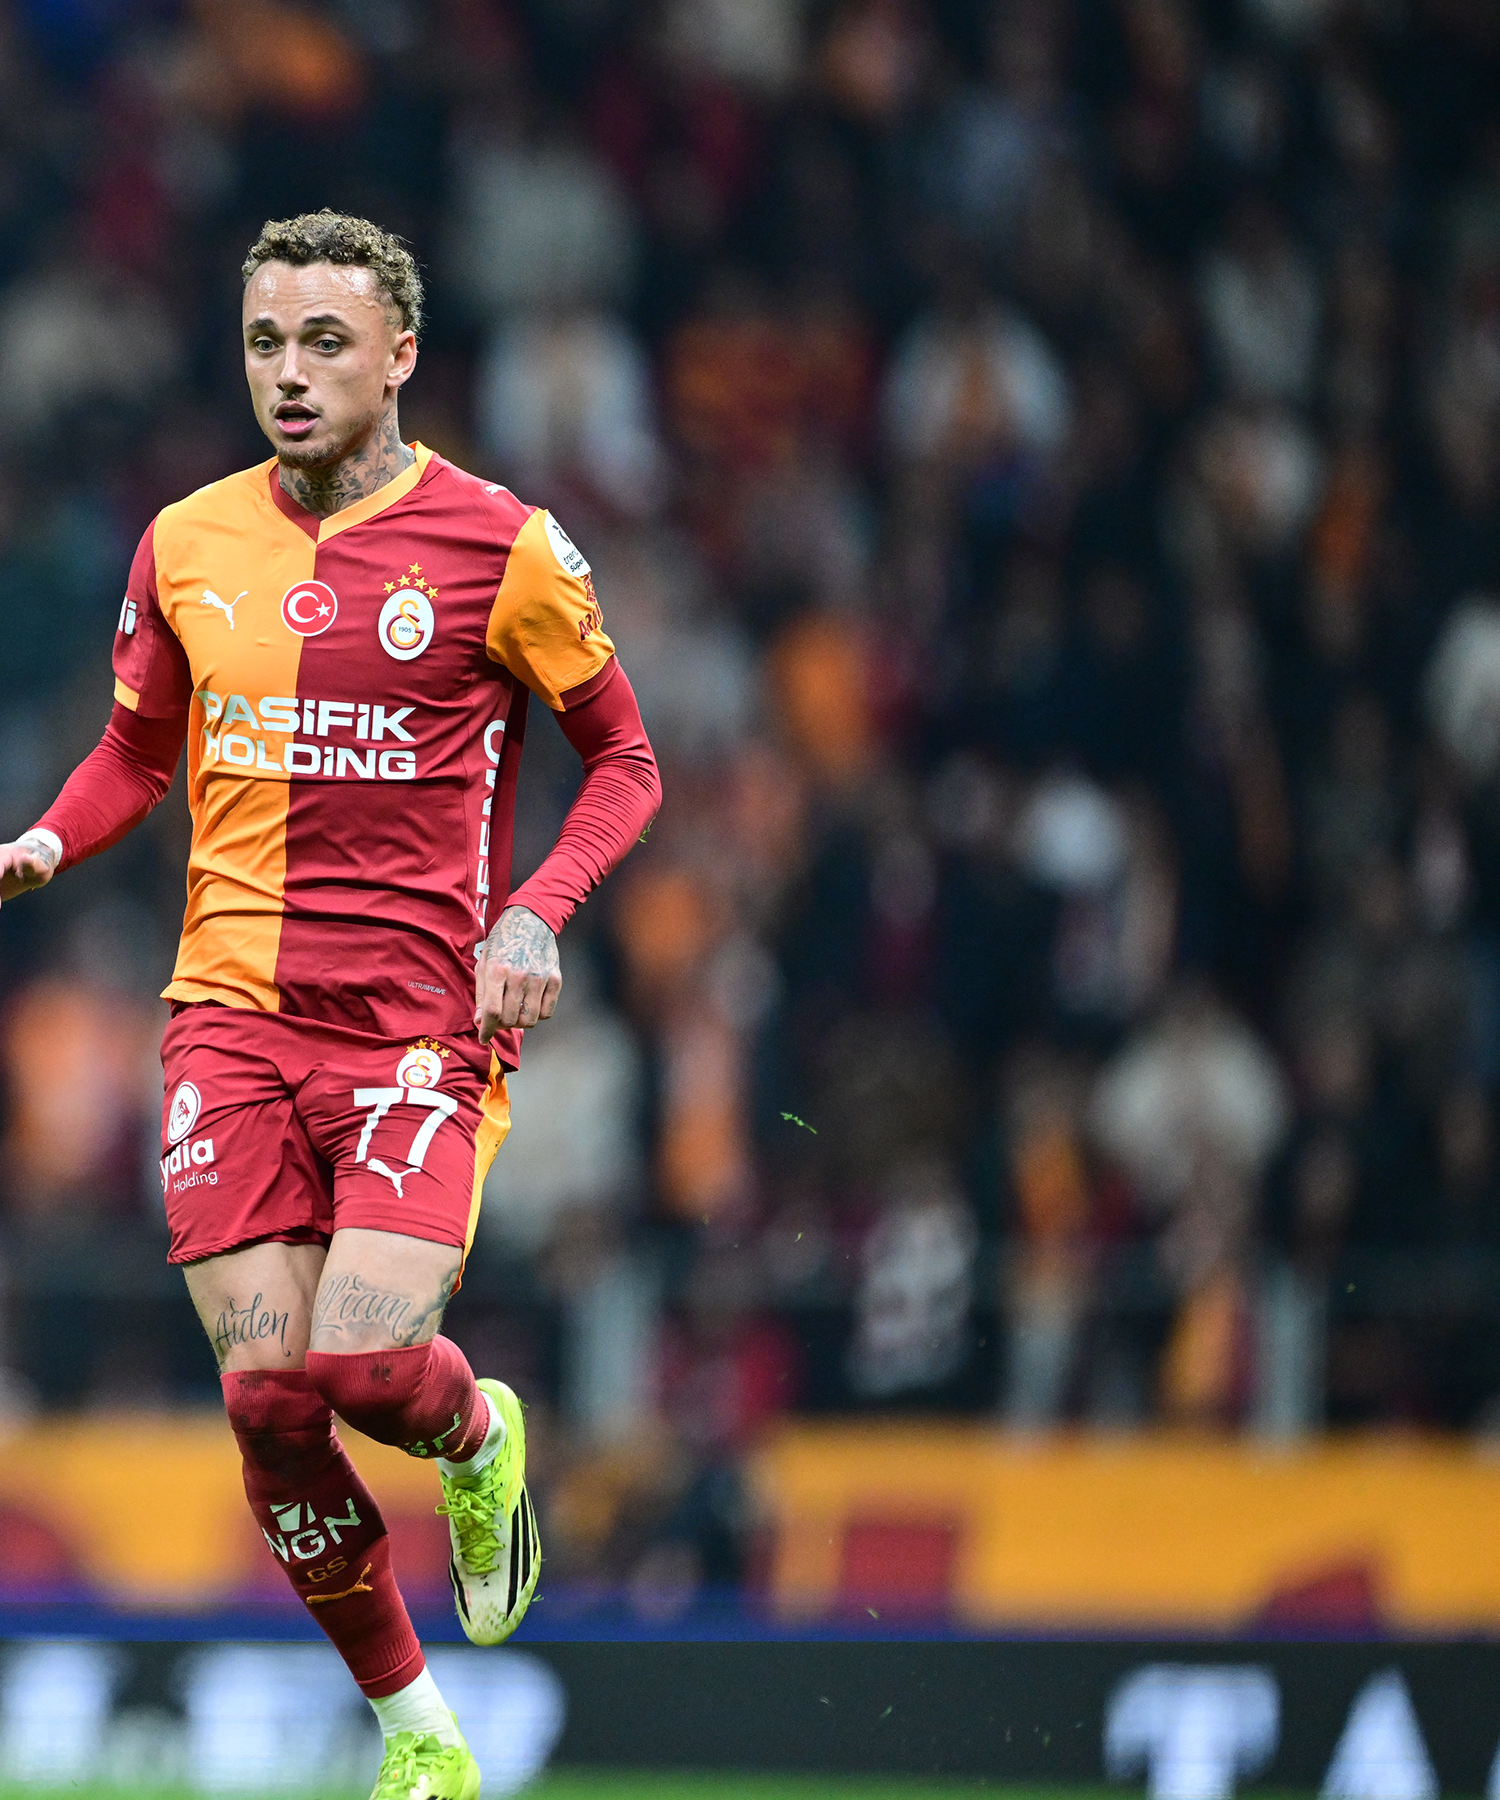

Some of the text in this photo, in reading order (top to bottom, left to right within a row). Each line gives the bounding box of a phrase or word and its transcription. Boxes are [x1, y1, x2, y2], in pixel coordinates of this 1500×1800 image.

[353, 1086, 458, 1167] 77
[160, 1138, 215, 1193] ydia
[173, 1171, 218, 1194] Holding
[307, 1556, 348, 1583] GS
